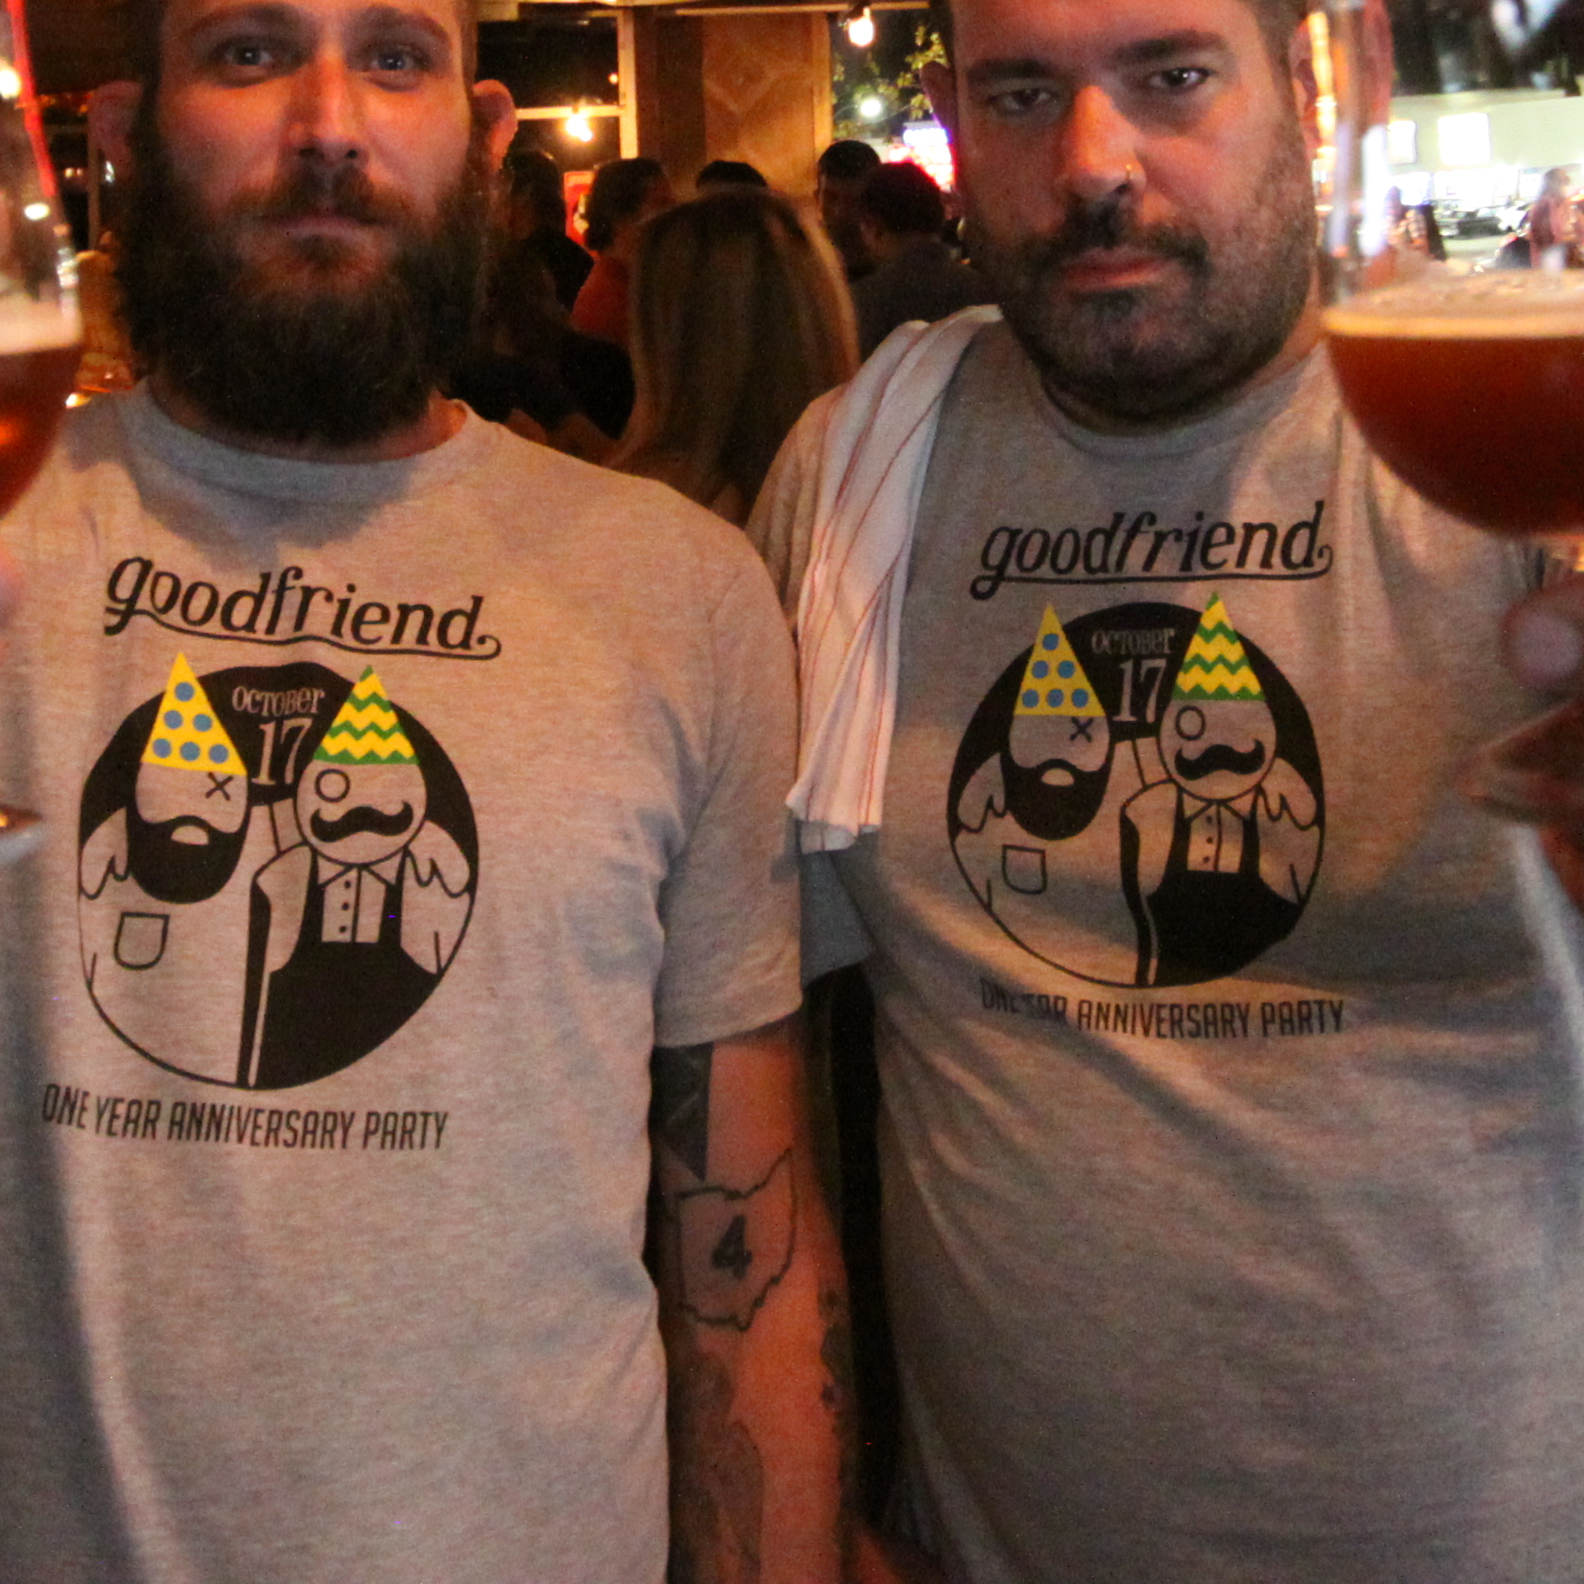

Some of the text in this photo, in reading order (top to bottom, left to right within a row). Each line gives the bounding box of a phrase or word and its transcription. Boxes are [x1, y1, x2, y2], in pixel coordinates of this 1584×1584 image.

[970, 500, 1330, 600] goodfriend
[104, 556, 501, 660] goodfriend
[1112, 658, 1167, 723] 17
[251, 717, 313, 785] 17
[1077, 999, 1250, 1039] ANNIVERSARY
[1261, 999, 1344, 1037] PARTY
[42, 1083, 448, 1150] ONE YEAR ANNIVERSARY PARTY
